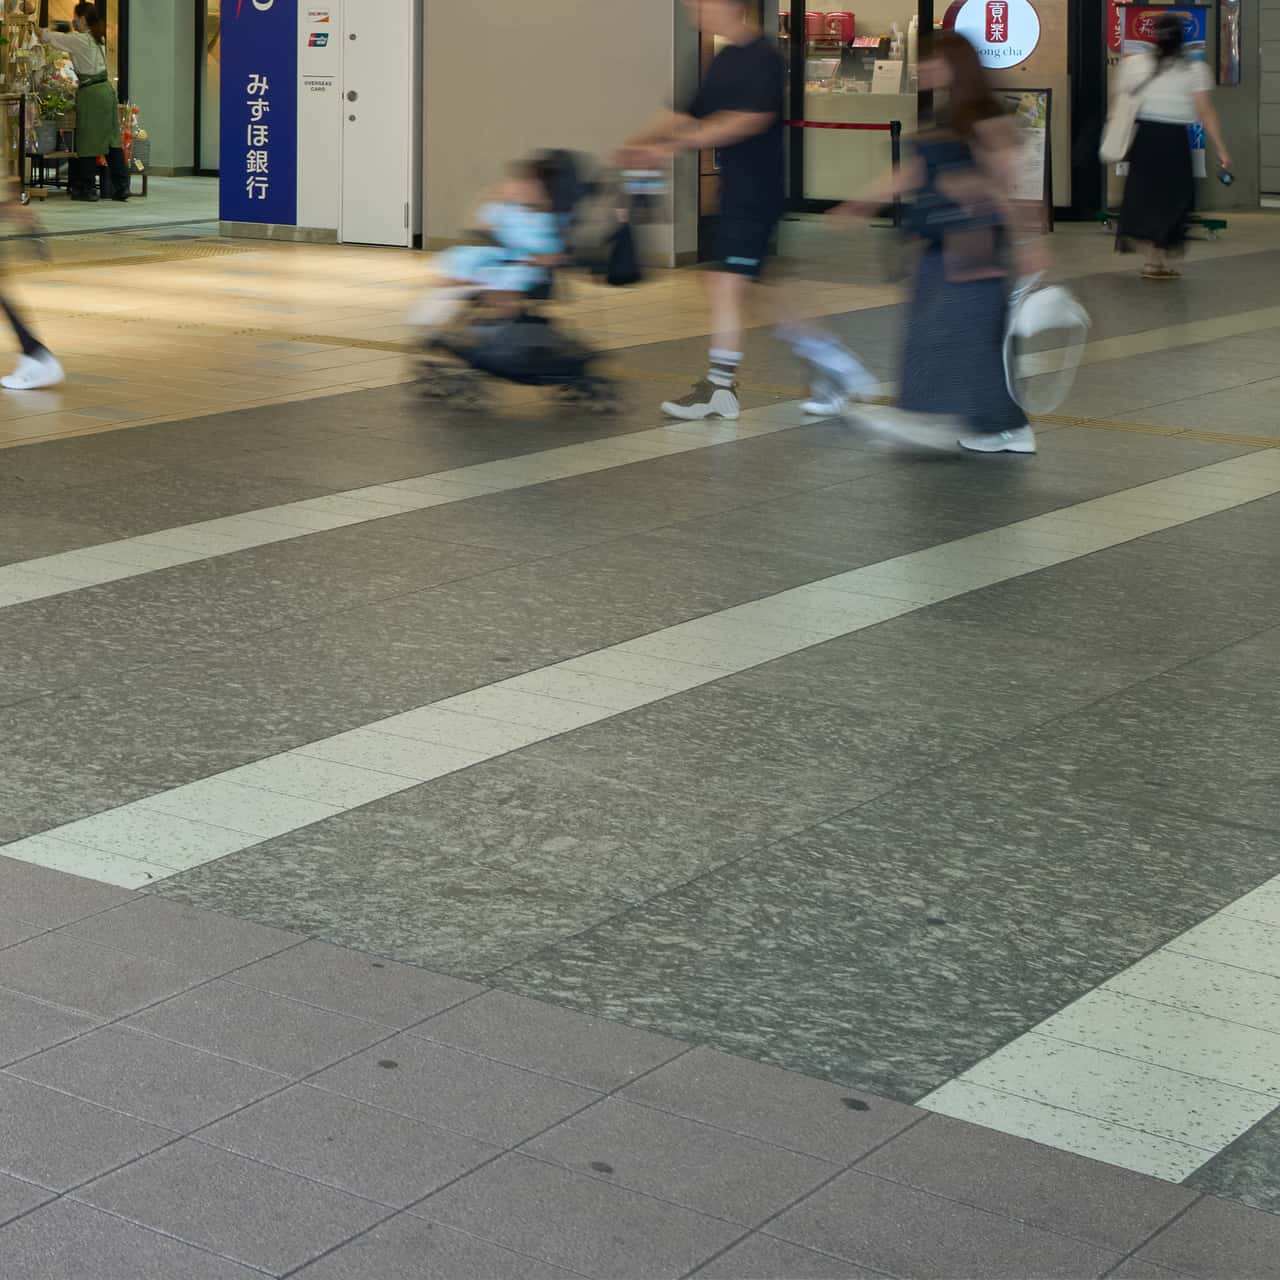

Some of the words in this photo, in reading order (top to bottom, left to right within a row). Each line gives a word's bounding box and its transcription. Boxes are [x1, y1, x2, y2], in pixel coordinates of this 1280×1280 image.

[987, 2, 1007, 41] 貢茶
[975, 48, 1001, 58] ong
[1002, 46, 1023, 57] cha
[246, 73, 270, 200] みずほ銀行
